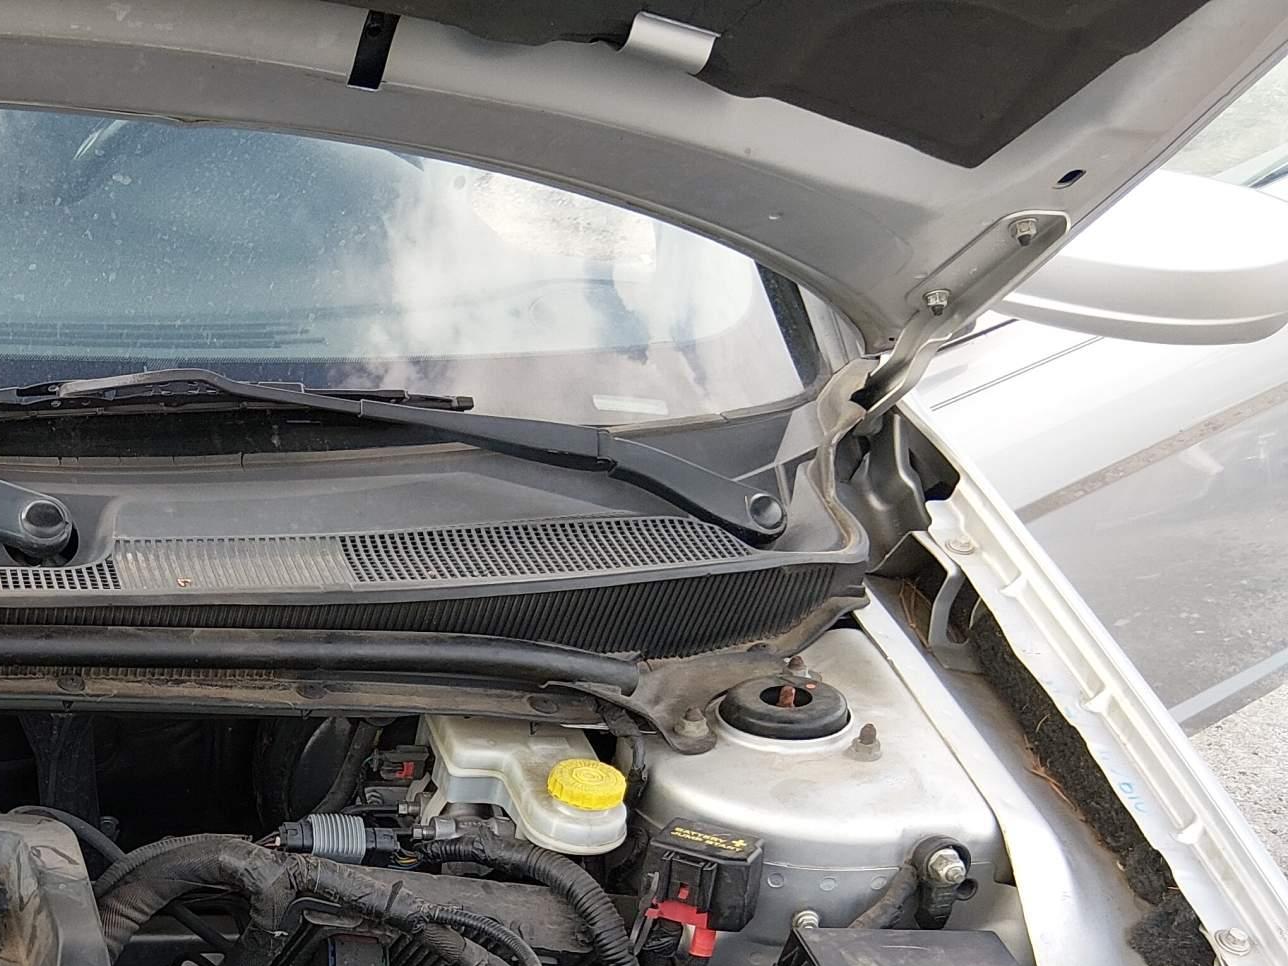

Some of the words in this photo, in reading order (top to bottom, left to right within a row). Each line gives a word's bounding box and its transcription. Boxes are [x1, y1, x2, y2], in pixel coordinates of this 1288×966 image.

[669, 831, 704, 842] JUMP
[704, 839, 744, 853] START
[673, 827, 728, 844] BATTERY
